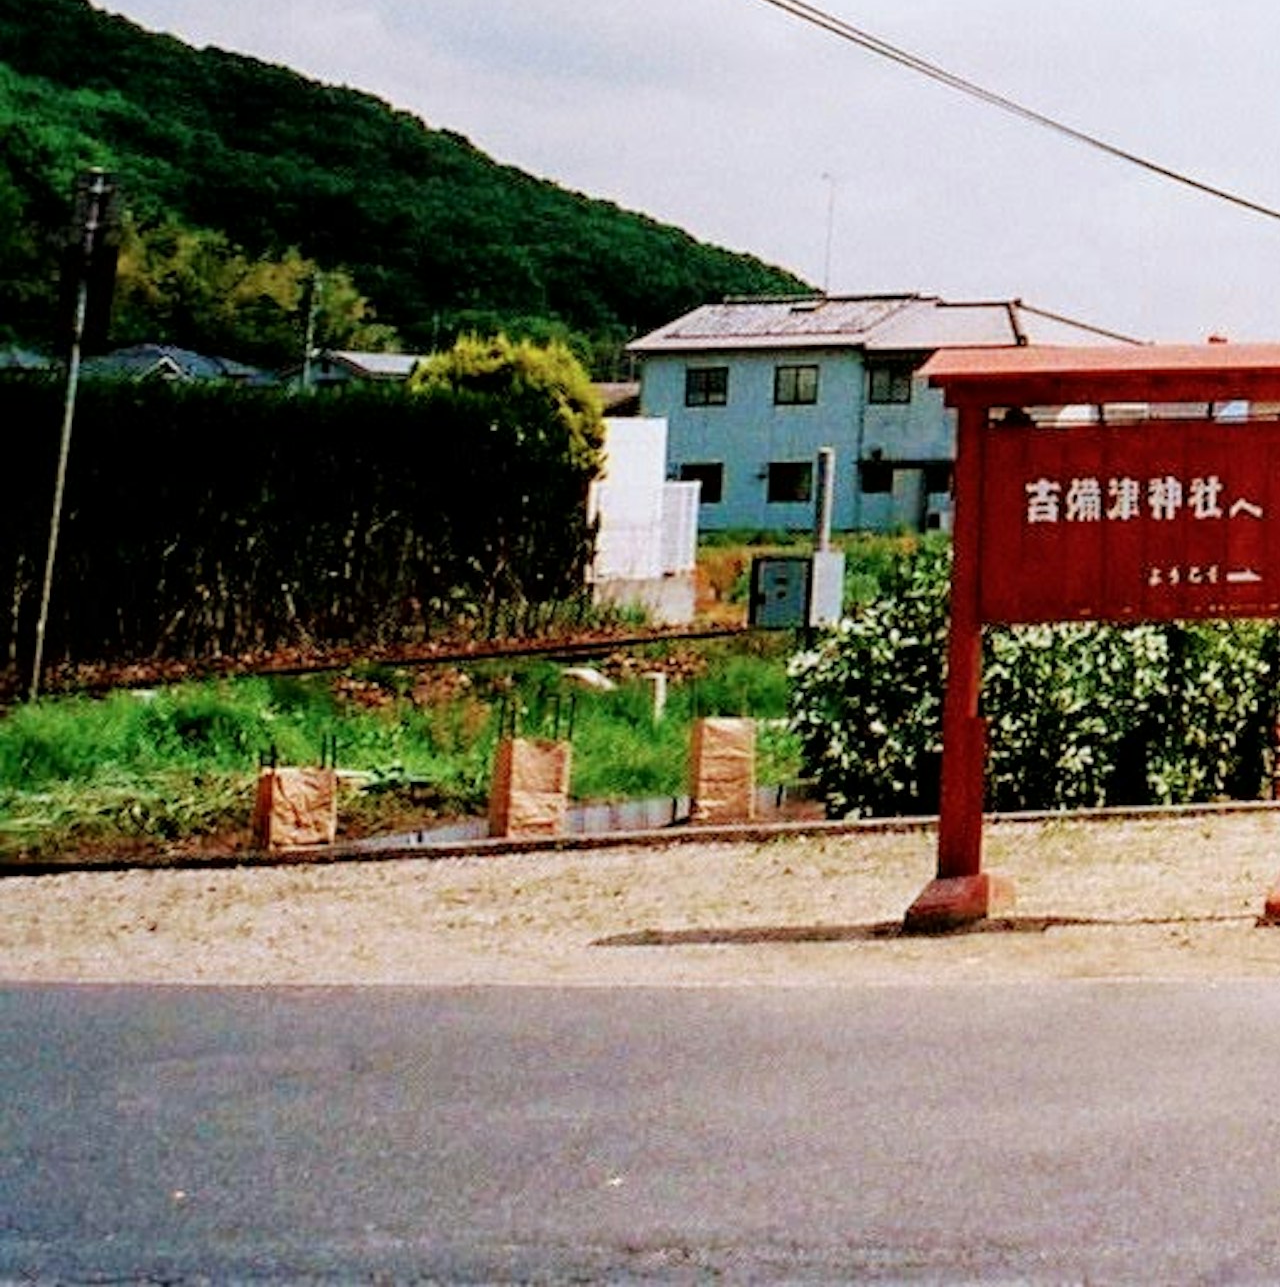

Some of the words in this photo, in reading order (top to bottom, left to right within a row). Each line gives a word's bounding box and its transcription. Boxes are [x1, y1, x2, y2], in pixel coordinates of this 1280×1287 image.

[1025, 475, 1264, 524] 吉備津神社へ
